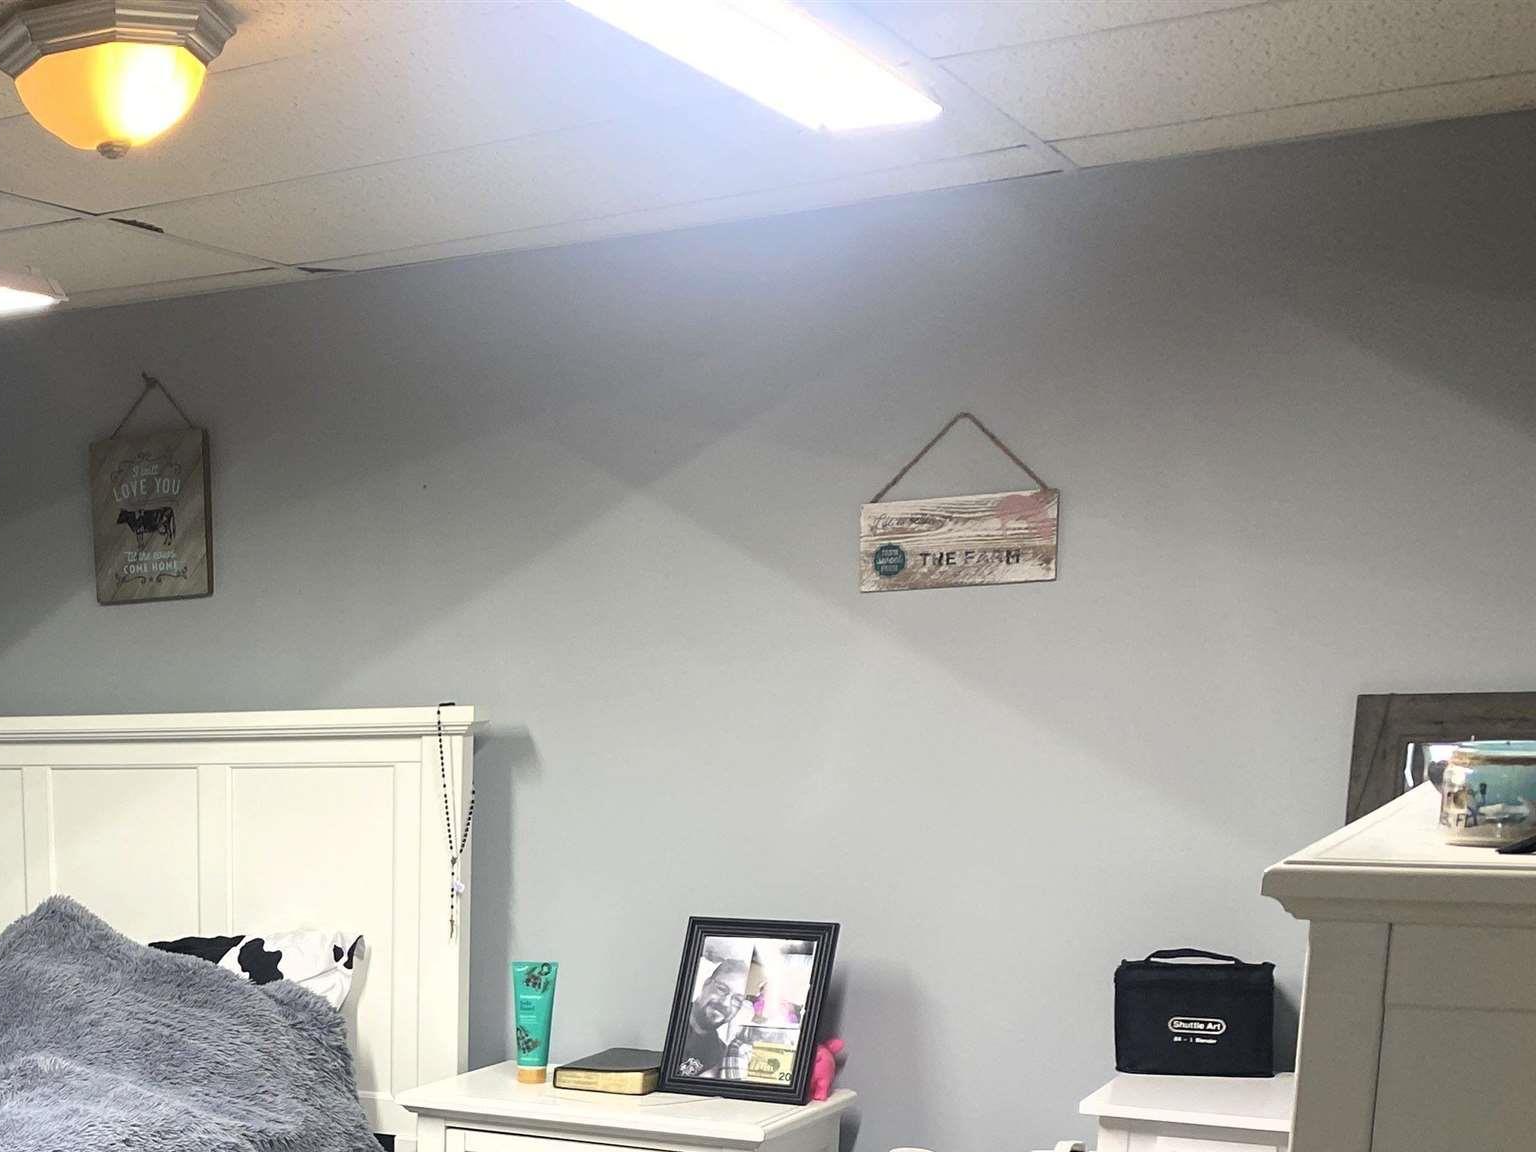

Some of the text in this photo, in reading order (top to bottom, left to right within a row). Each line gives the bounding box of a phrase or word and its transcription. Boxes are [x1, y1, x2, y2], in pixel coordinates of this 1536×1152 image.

[112, 478, 181, 503] LOVE YOU
[919, 548, 1022, 567] THE FARM
[123, 562, 149, 574] COME
[1173, 1020, 1221, 1031] Shuttle Art
[778, 1072, 792, 1082] 20
